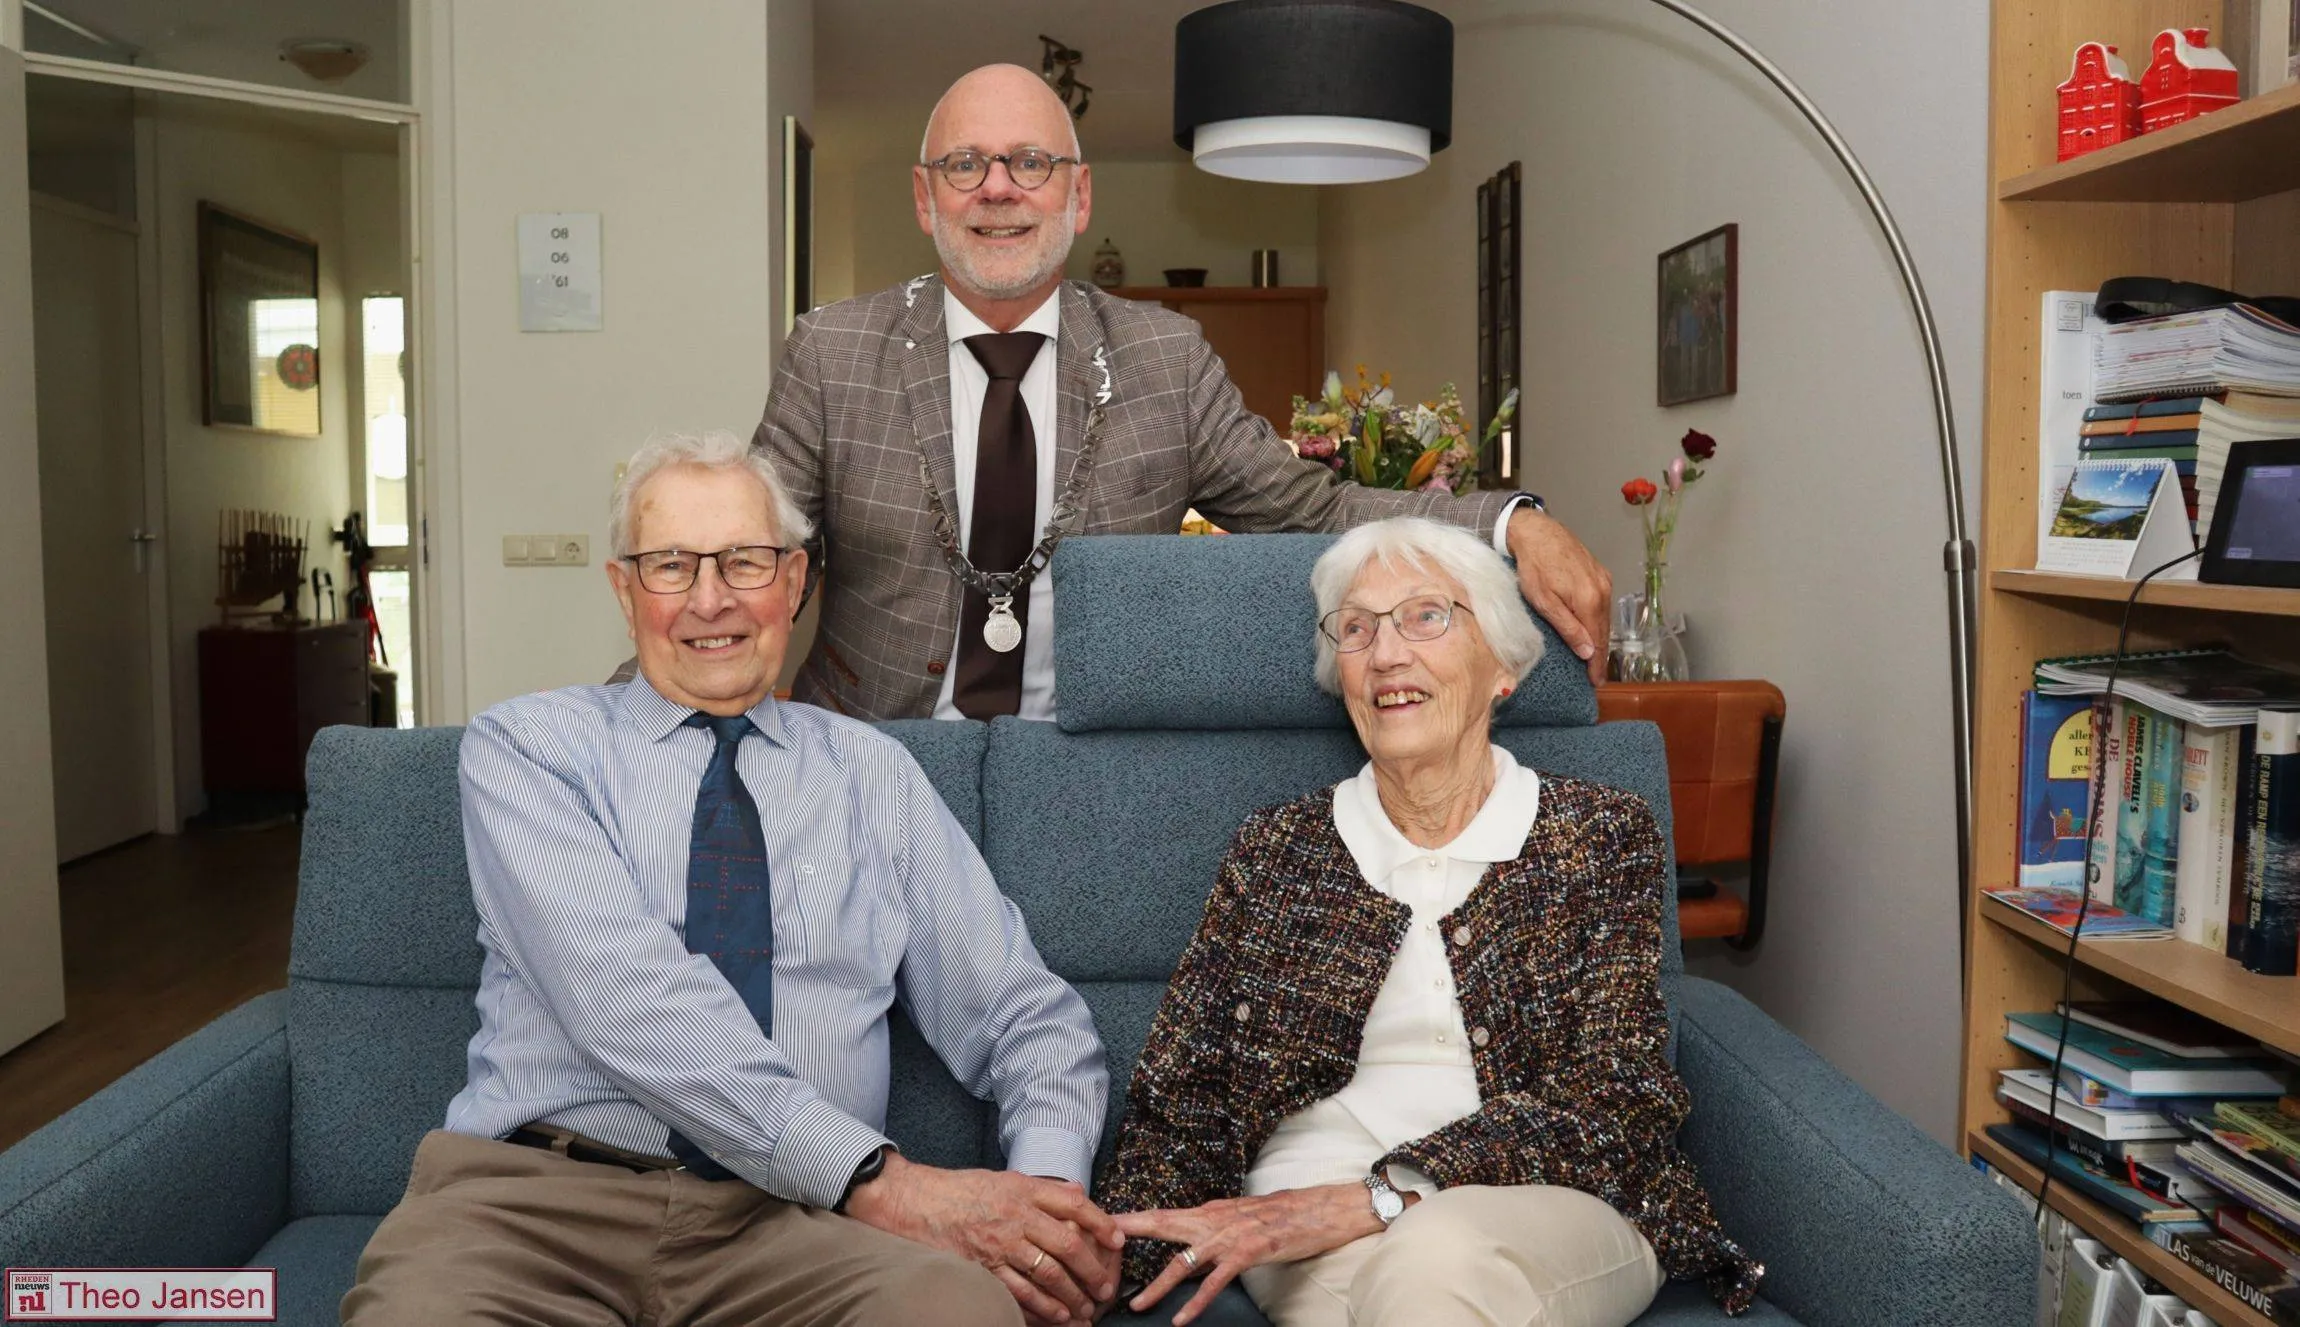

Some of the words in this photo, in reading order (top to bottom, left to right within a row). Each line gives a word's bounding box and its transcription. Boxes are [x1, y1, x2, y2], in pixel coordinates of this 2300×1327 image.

[550, 252, 570, 264] 06
[2126, 715, 2138, 756] NOBLE
[2134, 715, 2146, 754] JAMES
[2109, 739, 2120, 761] DE
[2261, 755, 2271, 770] DE
[2259, 770, 2270, 799] RAMP
[2257, 800, 2268, 820] EEN
[2151, 1226, 2191, 1262] ATLAS
[2190, 1254, 2204, 1269] van
[2215, 1264, 2273, 1317] VELUWE
